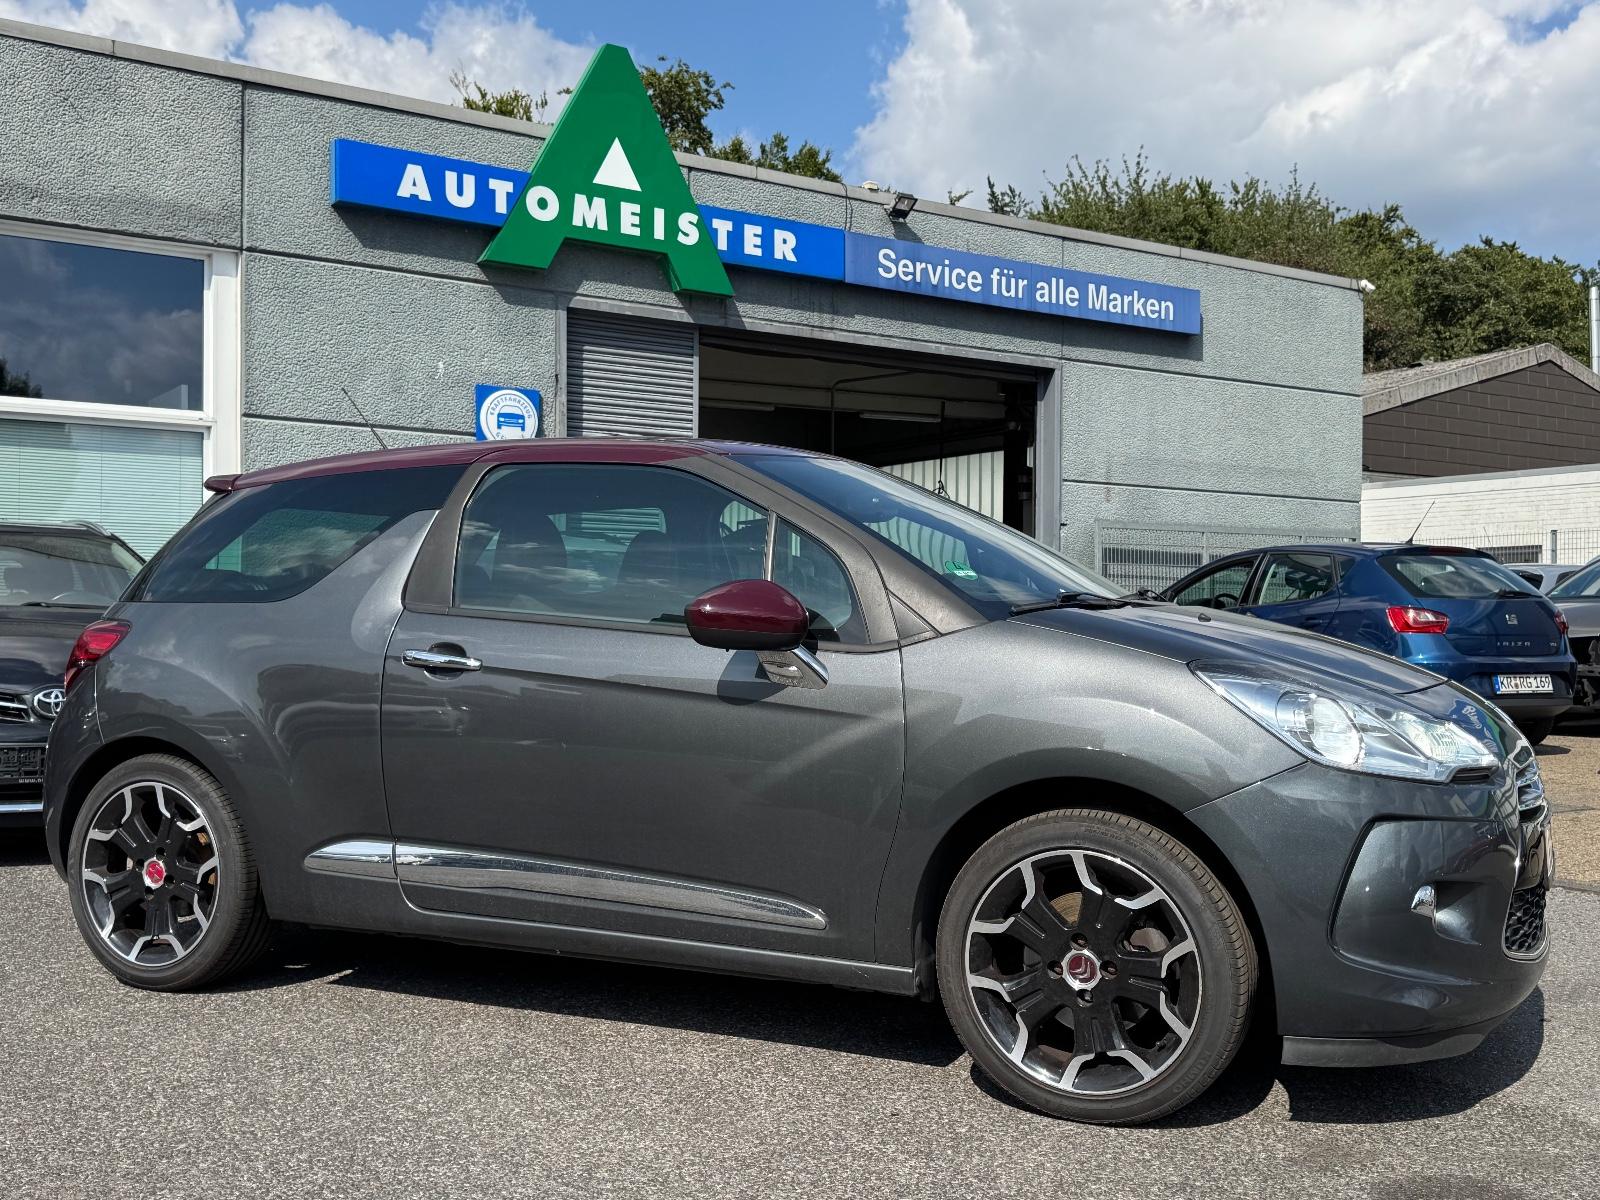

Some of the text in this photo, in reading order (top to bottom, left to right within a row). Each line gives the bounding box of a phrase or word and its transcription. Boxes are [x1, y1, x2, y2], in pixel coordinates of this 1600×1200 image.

[397, 164, 798, 262] AUTOMEISTER
[877, 248, 1174, 321] Service für alle Marken
[1500, 676, 1550, 689] KR RG 169
